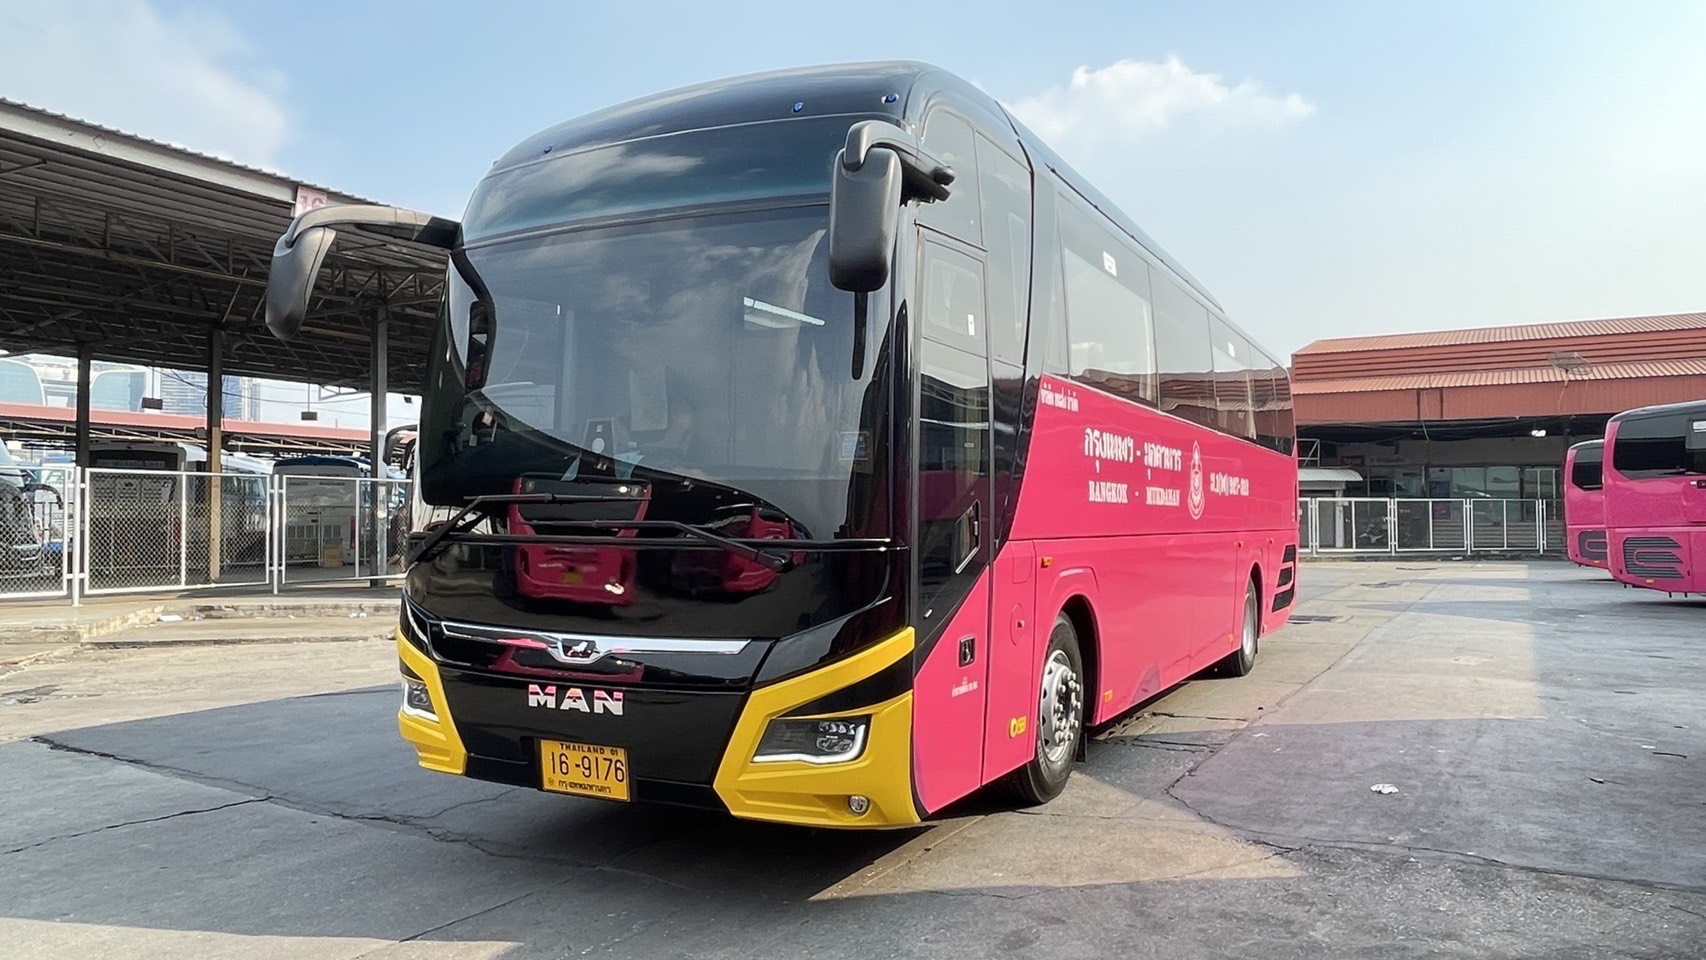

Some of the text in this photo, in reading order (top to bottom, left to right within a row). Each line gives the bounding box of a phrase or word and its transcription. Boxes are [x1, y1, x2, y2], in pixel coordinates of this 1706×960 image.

[1089, 480, 1128, 503] BANGKOK
[1146, 486, 1180, 506] MUKDAHAN
[529, 684, 623, 715] MAN
[560, 743, 605, 755] THAILAND
[551, 751, 625, 783] 16-9176
